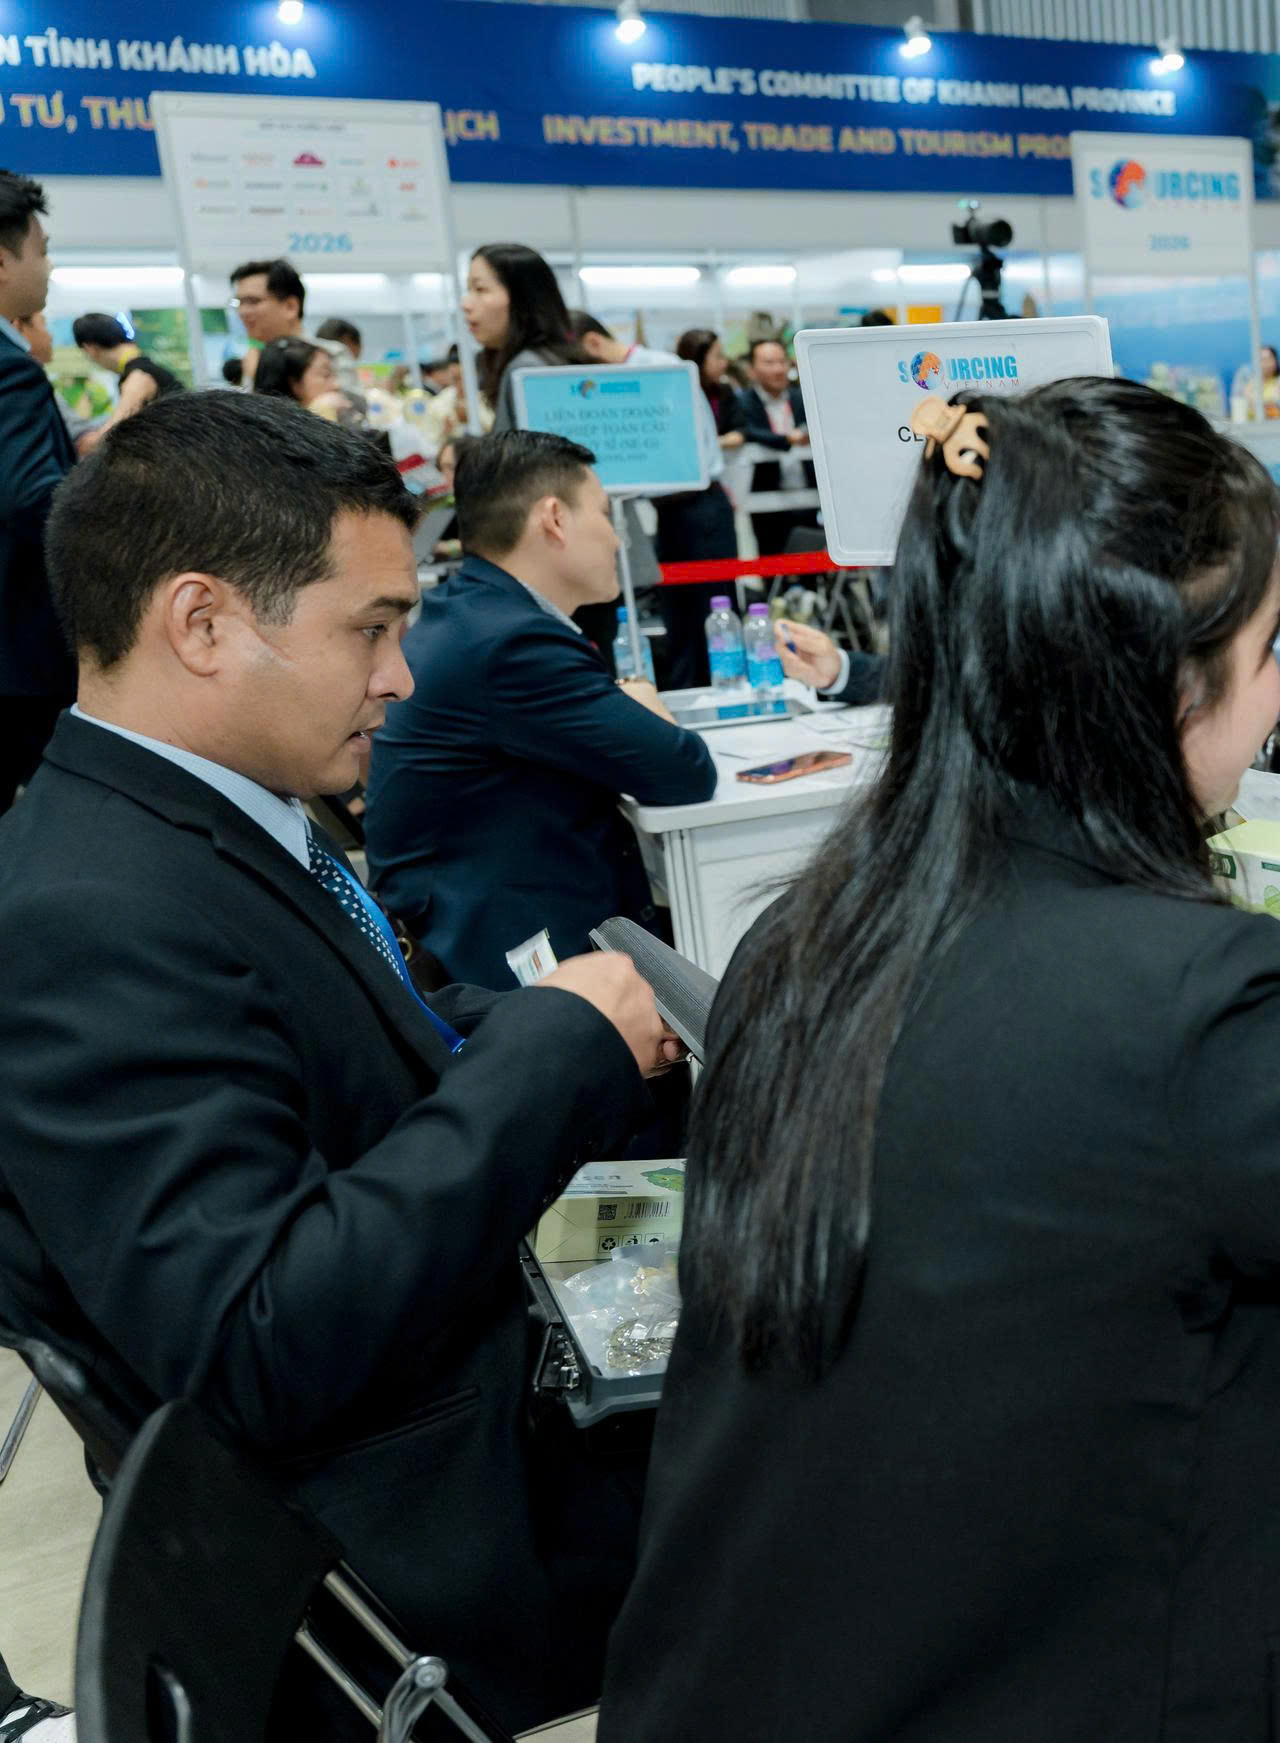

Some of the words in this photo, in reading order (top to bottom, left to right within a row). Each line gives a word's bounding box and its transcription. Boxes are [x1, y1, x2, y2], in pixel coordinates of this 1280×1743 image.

[24, 27, 113, 69] TỈNH
[118, 36, 240, 76] KHÁNH
[243, 40, 317, 78] HÒA
[631, 62, 757, 95] PEOPLE'S
[759, 69, 900, 103] COMMITTEE
[901, 76, 935, 104] OF
[937, 78, 1020, 107] KHANH
[1022, 84, 1071, 110] HOA
[1071, 86, 1176, 116] PROVINCE
[443, 108, 500, 146] ỊCH
[543, 114, 740, 153] INVESTMENT,
[743, 121, 833, 152] TRADE
[839, 126, 897, 155] AND
[898, 127, 1014, 158] TOURISM
[288, 232, 352, 253] 2026
[943, 379, 1020, 391] VIETNAM
